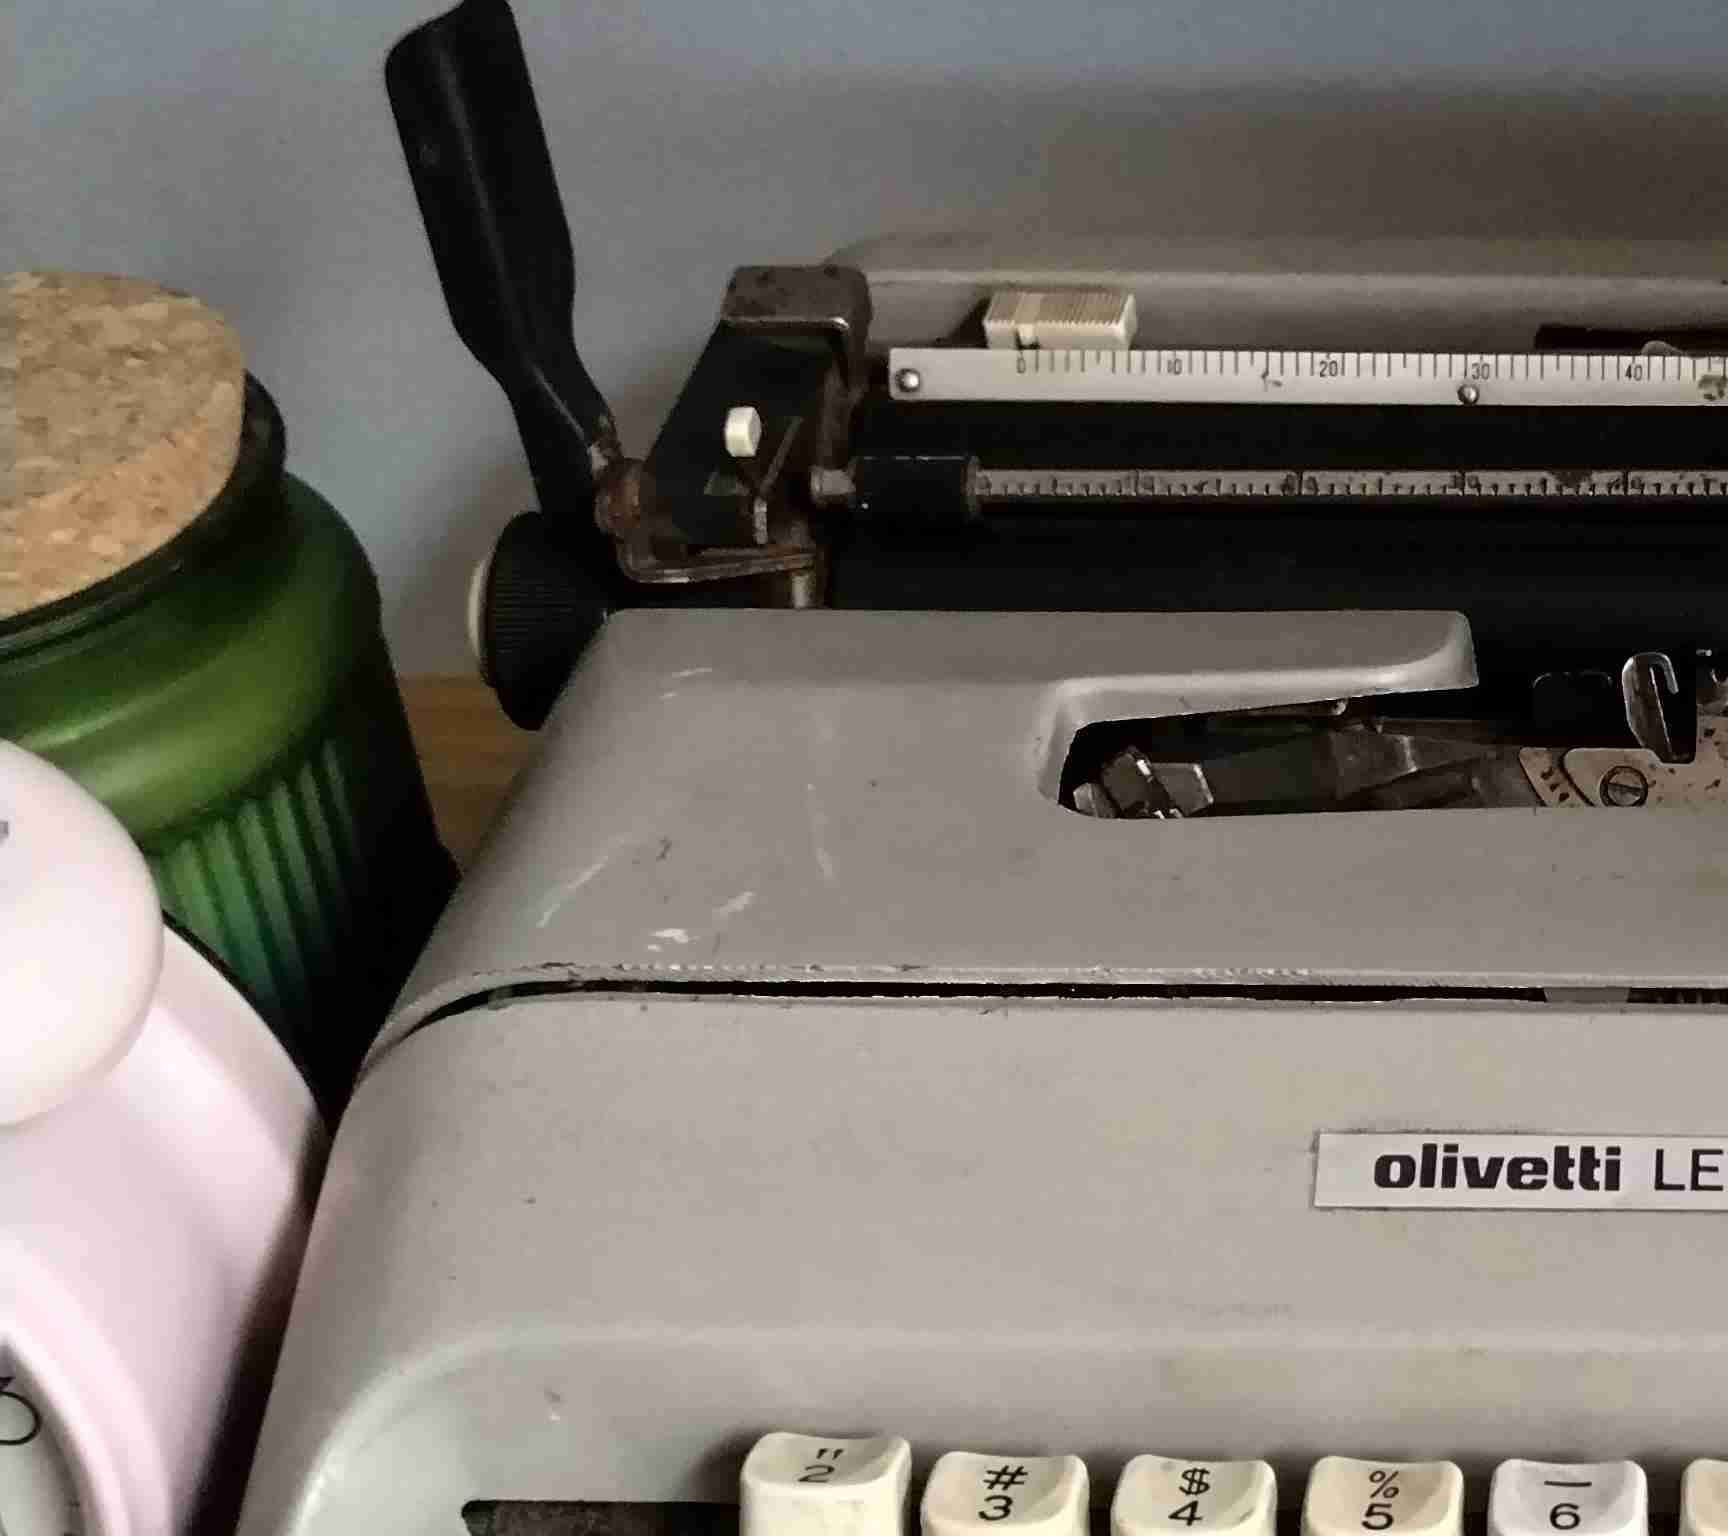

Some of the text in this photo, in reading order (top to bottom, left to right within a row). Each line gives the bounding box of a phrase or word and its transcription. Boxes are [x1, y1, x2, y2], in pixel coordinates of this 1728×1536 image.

[1318, 359, 1339, 378] 20
[1470, 362, 1491, 381] 30
[1624, 363, 1643, 383] 40
[1373, 1143, 1622, 1192] olivetti
[798, 1464, 836, 1483] 2
[978, 1494, 1014, 1521] 3
[1168, 1500, 1203, 1527] 4
[1361, 1502, 1395, 1531] 5
[1549, 1502, 1581, 1530] 6
